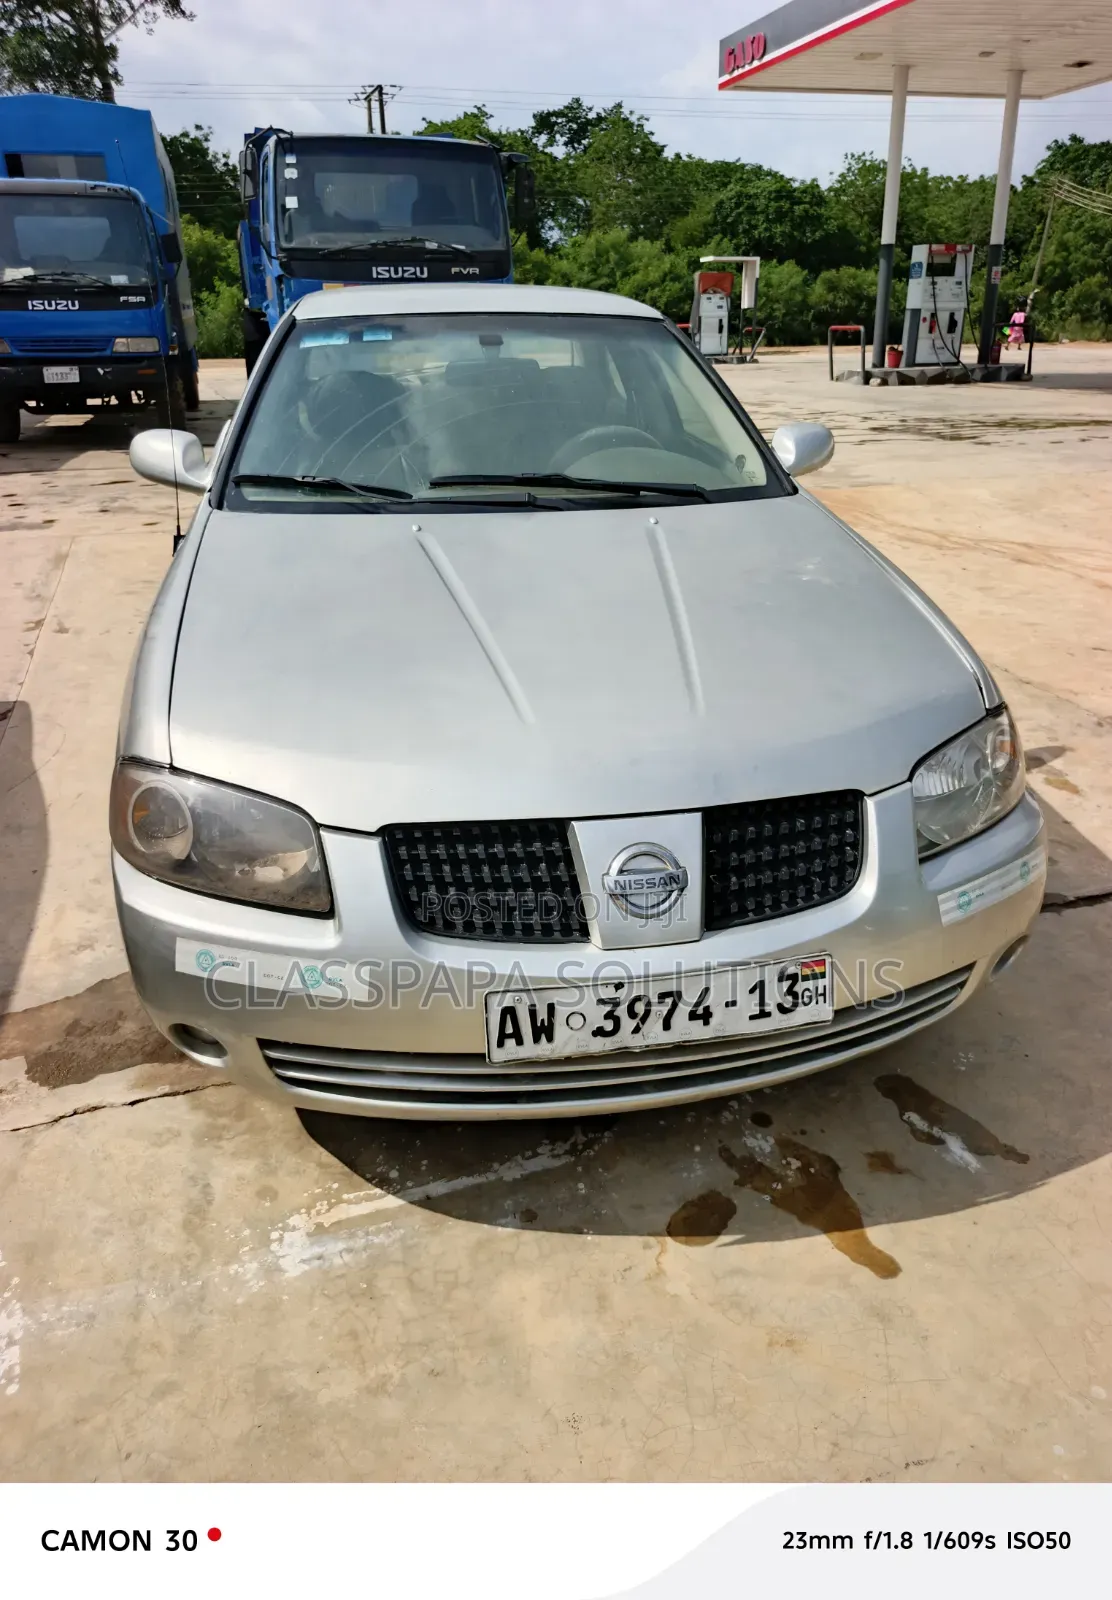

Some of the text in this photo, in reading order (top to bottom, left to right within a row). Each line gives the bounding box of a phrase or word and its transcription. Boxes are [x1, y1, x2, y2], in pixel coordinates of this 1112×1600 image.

[724, 31, 767, 75] GASO
[372, 266, 428, 279] ISUZU
[451, 266, 479, 275] FVR
[28, 299, 79, 311] ISUZU
[613, 870, 681, 892] NISSAN
[800, 983, 827, 1006] GH
[496, 1002, 556, 1048] AW
